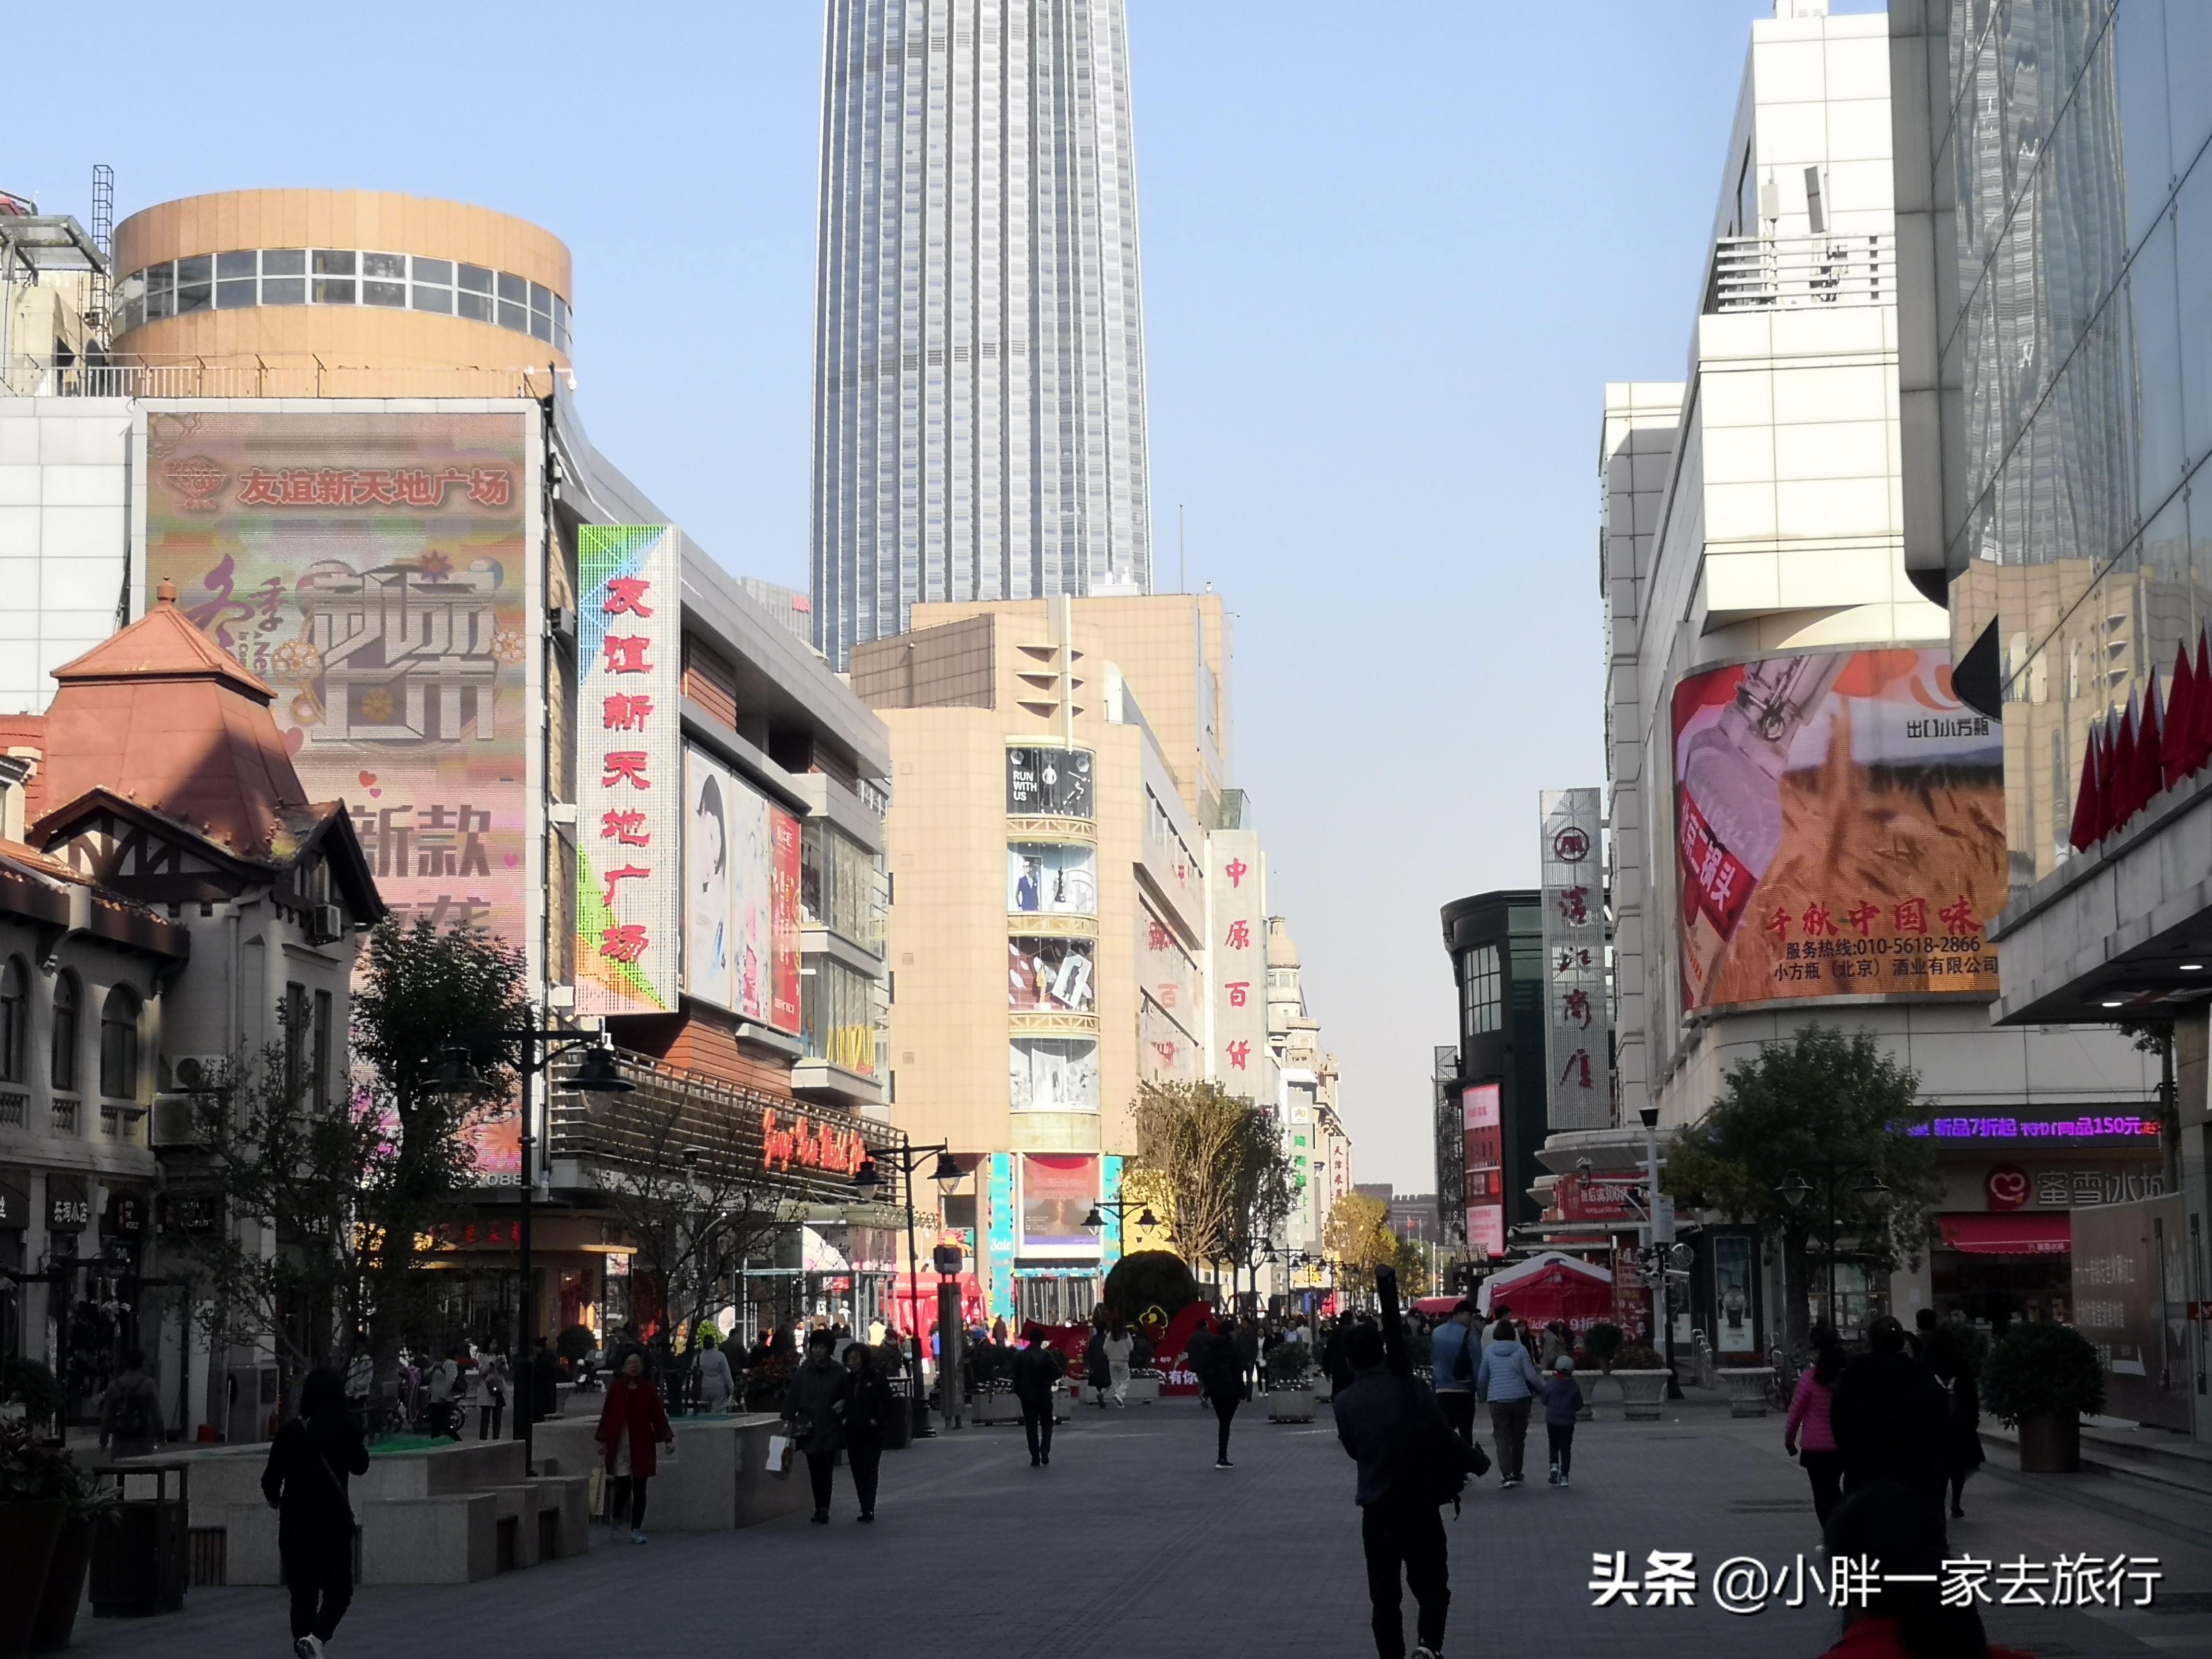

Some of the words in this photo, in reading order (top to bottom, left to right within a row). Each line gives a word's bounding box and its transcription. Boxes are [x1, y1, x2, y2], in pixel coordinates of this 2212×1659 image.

[239, 467, 509, 505] 友谊新天地广场
[1907, 718, 1990, 738] 出口小方瓶
[601, 576, 654, 962] 友谊新天地广场
[1013, 770, 1034, 781] RUN
[1013, 781, 1037, 792] WITH
[1013, 791, 1027, 801] US
[1786, 936, 1981, 960] 服务热线:010-5618-2866
[1225, 857, 1250, 1070] 中原百货
[1934, 1118, 2018, 1138] 新品7折起
[2036, 1170, 2164, 1205] 蜜雪冰城
[990, 1238, 1011, 1251] Sale
